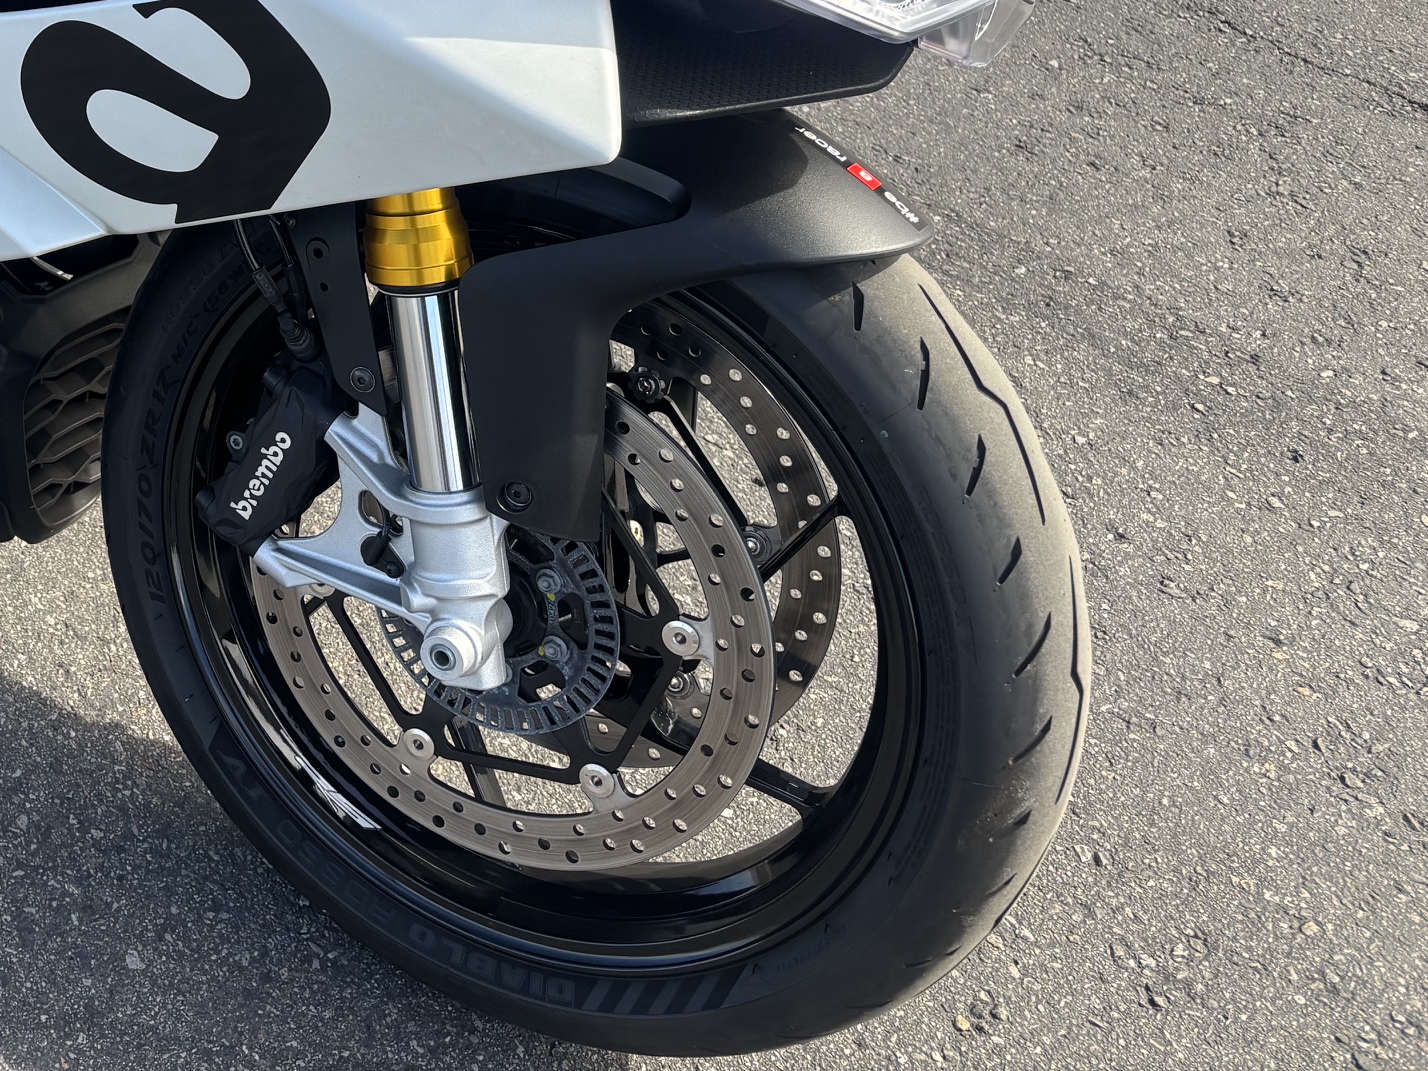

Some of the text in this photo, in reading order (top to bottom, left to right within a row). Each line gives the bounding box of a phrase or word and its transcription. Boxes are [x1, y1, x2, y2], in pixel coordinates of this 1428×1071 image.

[794, 126, 848, 162] racer
[884, 191, 920, 224] #be
[229, 431, 292, 521] brembo
[407, 921, 576, 1006] DIABLO
